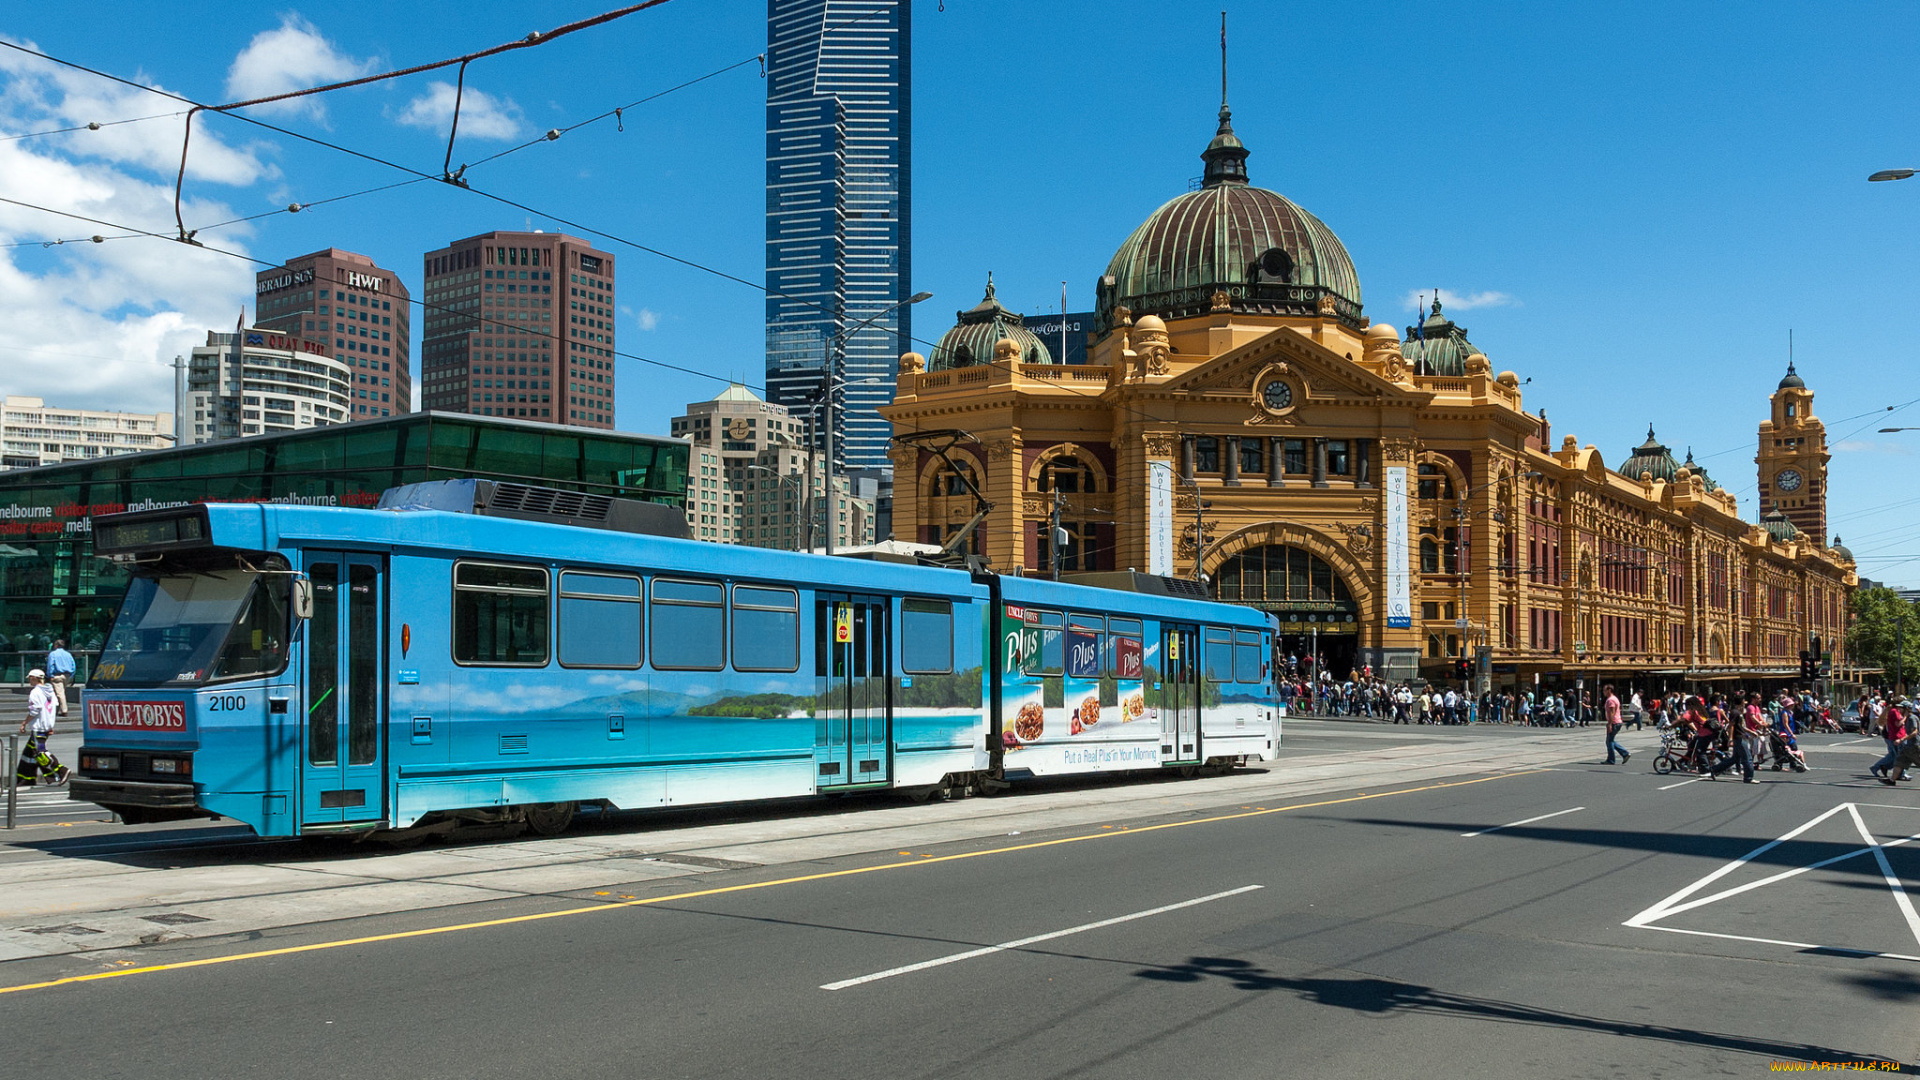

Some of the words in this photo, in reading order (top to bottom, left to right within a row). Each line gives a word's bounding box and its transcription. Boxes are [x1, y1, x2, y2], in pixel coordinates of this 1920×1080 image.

[257, 273, 292, 293] HERALD
[294, 269, 313, 284] SUN
[348, 271, 382, 291] HWT
[268, 334, 299, 350] QUAY
[303, 340, 325, 356] WEST
[340, 489, 380, 506] visitor
[1394, 477, 1402, 511] world
[54, 501, 88, 516] visitor
[91, 501, 125, 516] centre
[31, 520, 64, 534] centre
[1007, 605, 1024, 619] UNCLE
[1005, 628, 1038, 674] Plus
[1072, 641, 1095, 675] Plus
[92, 663, 125, 681] 2100
[1123, 652, 1140, 677] Plus
[209, 695, 246, 712] 2100
[89, 703, 132, 726] UNCLE
[132, 704, 183, 728] TOBYS
[1064, 750, 1076, 764] Put
[1083, 749, 1097, 763] Real
[1098, 748, 1112, 762] Plus
[1119, 748, 1132, 761] Your
[1133, 746, 1157, 762] Morning
